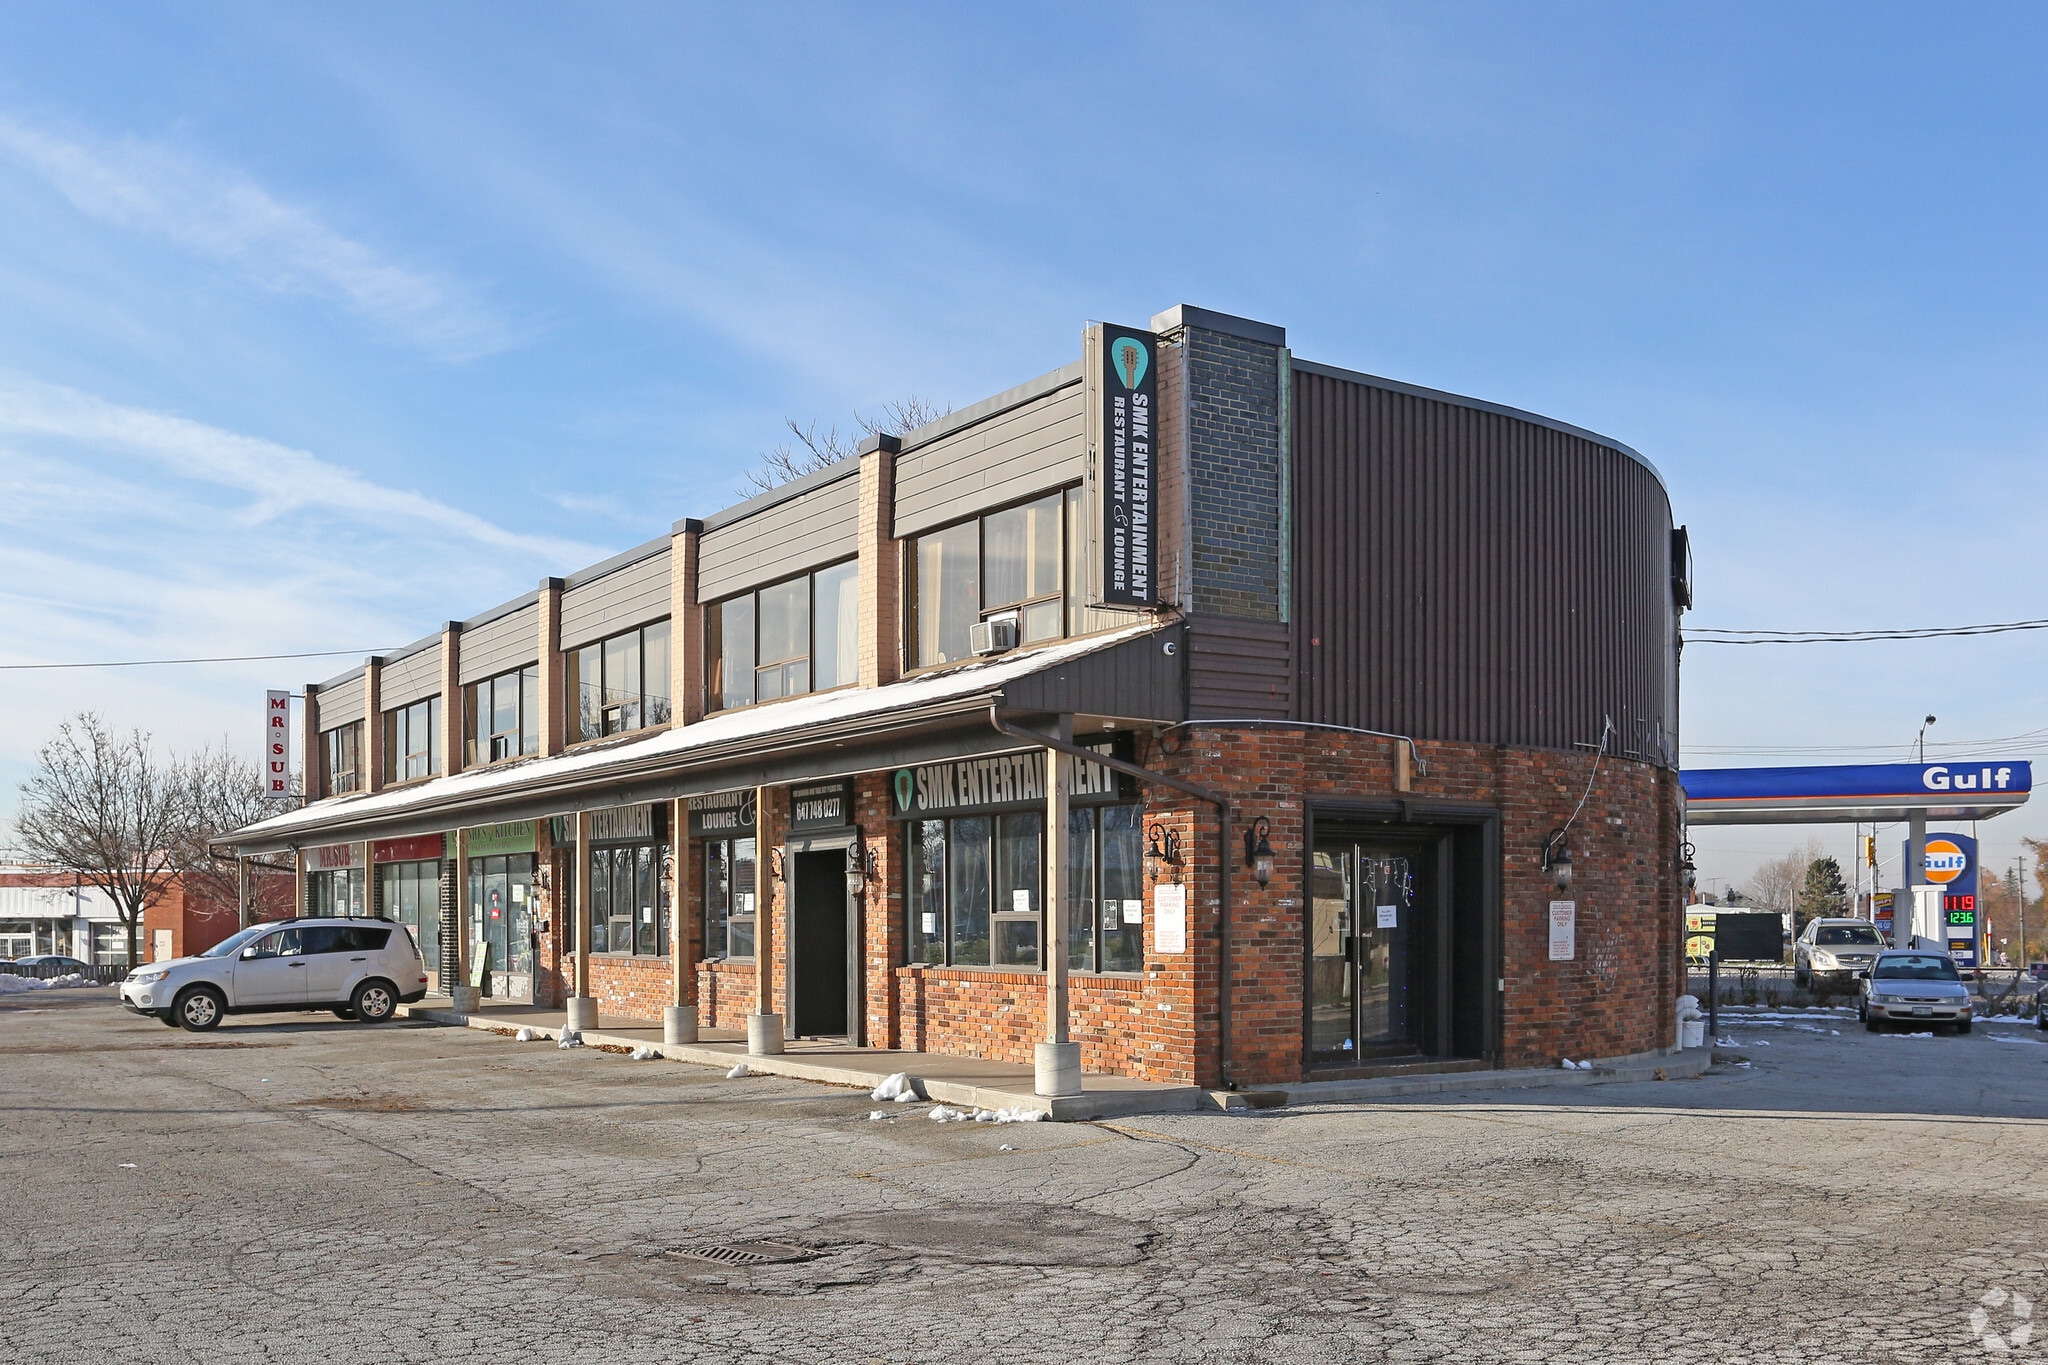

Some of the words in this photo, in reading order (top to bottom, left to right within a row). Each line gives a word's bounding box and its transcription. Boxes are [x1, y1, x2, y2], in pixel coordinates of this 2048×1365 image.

[1132, 392, 1149, 439] SMK
[1113, 396, 1126, 502] RESTAURANT
[1113, 504, 1129, 527] &
[1131, 440, 1149, 601] ENTERTAINMENT
[1113, 528, 1125, 592] LOUNGE
[270, 742, 286, 792] SUB
[1922, 766, 2012, 790] Gulf
[688, 791, 744, 811] RESTAURANT
[916, 763, 956, 811] SMK
[563, 813, 577, 842] SM
[588, 804, 653, 840] NTERTAINMENT
[702, 811, 738, 830] LOUNGE
[796, 801, 809, 821] 647
[809, 799, 823, 820] 748
[823, 797, 841, 818] 0277
[495, 820, 531, 840] KITCHEN
